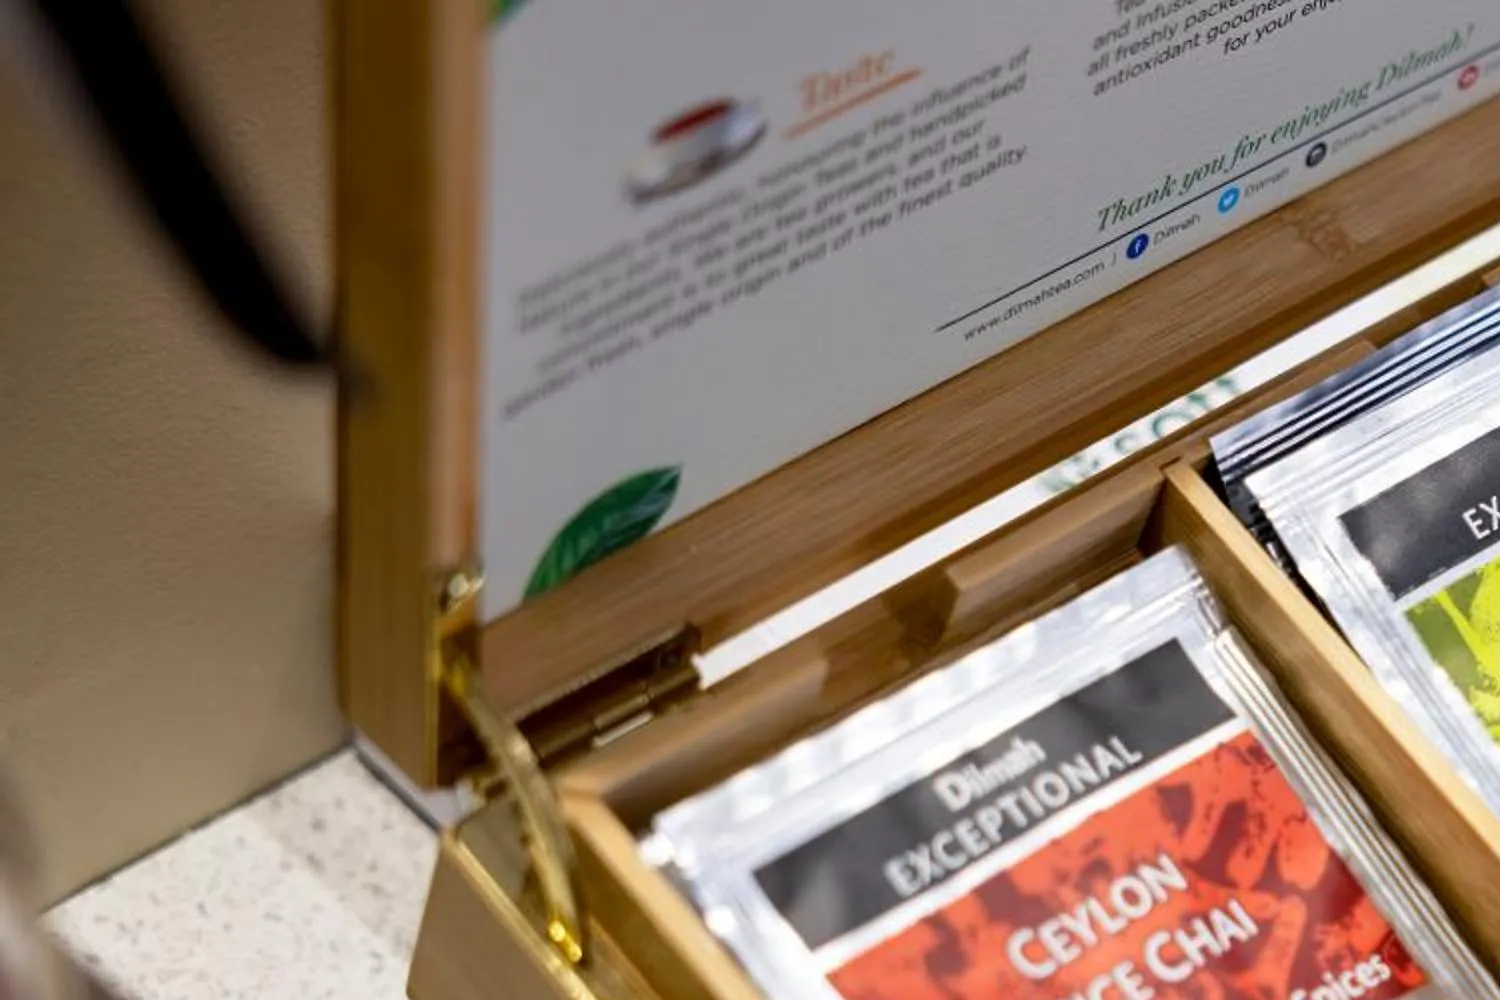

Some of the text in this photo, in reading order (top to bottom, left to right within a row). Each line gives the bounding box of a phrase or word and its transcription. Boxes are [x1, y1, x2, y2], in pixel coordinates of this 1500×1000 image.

[1087, 50, 1110, 77] all
[1115, 22, 1179, 64] freshly
[1183, 0, 1239, 33] packe
[1092, 32, 1200, 97] antioxidant
[1093, 19, 1131, 51] and
[1223, 32, 1251, 55] for
[1253, 9, 1297, 44] your
[908, 71, 1028, 141] handpicked
[910, 63, 1002, 117] influence
[1008, 44, 1031, 71] of
[907, 133, 948, 167] and
[952, 118, 987, 146] our
[1097, 174, 1179, 233] Thank
[1175, 152, 1230, 199] you
[1226, 132, 1268, 174] for
[1269, 76, 1372, 142] enjoying
[853, 184, 899, 216] with
[940, 143, 981, 175] that
[858, 212, 893, 239] the
[898, 179, 955, 219] finest
[1152, 212, 1201, 246] Dilmah
[932, 735, 1046, 813] Dilmah
[883, 736, 1142, 897] EXCEPTIONAL
[1006, 854, 1188, 981] CEYLON
[1145, 899, 1260, 984] CHAI
